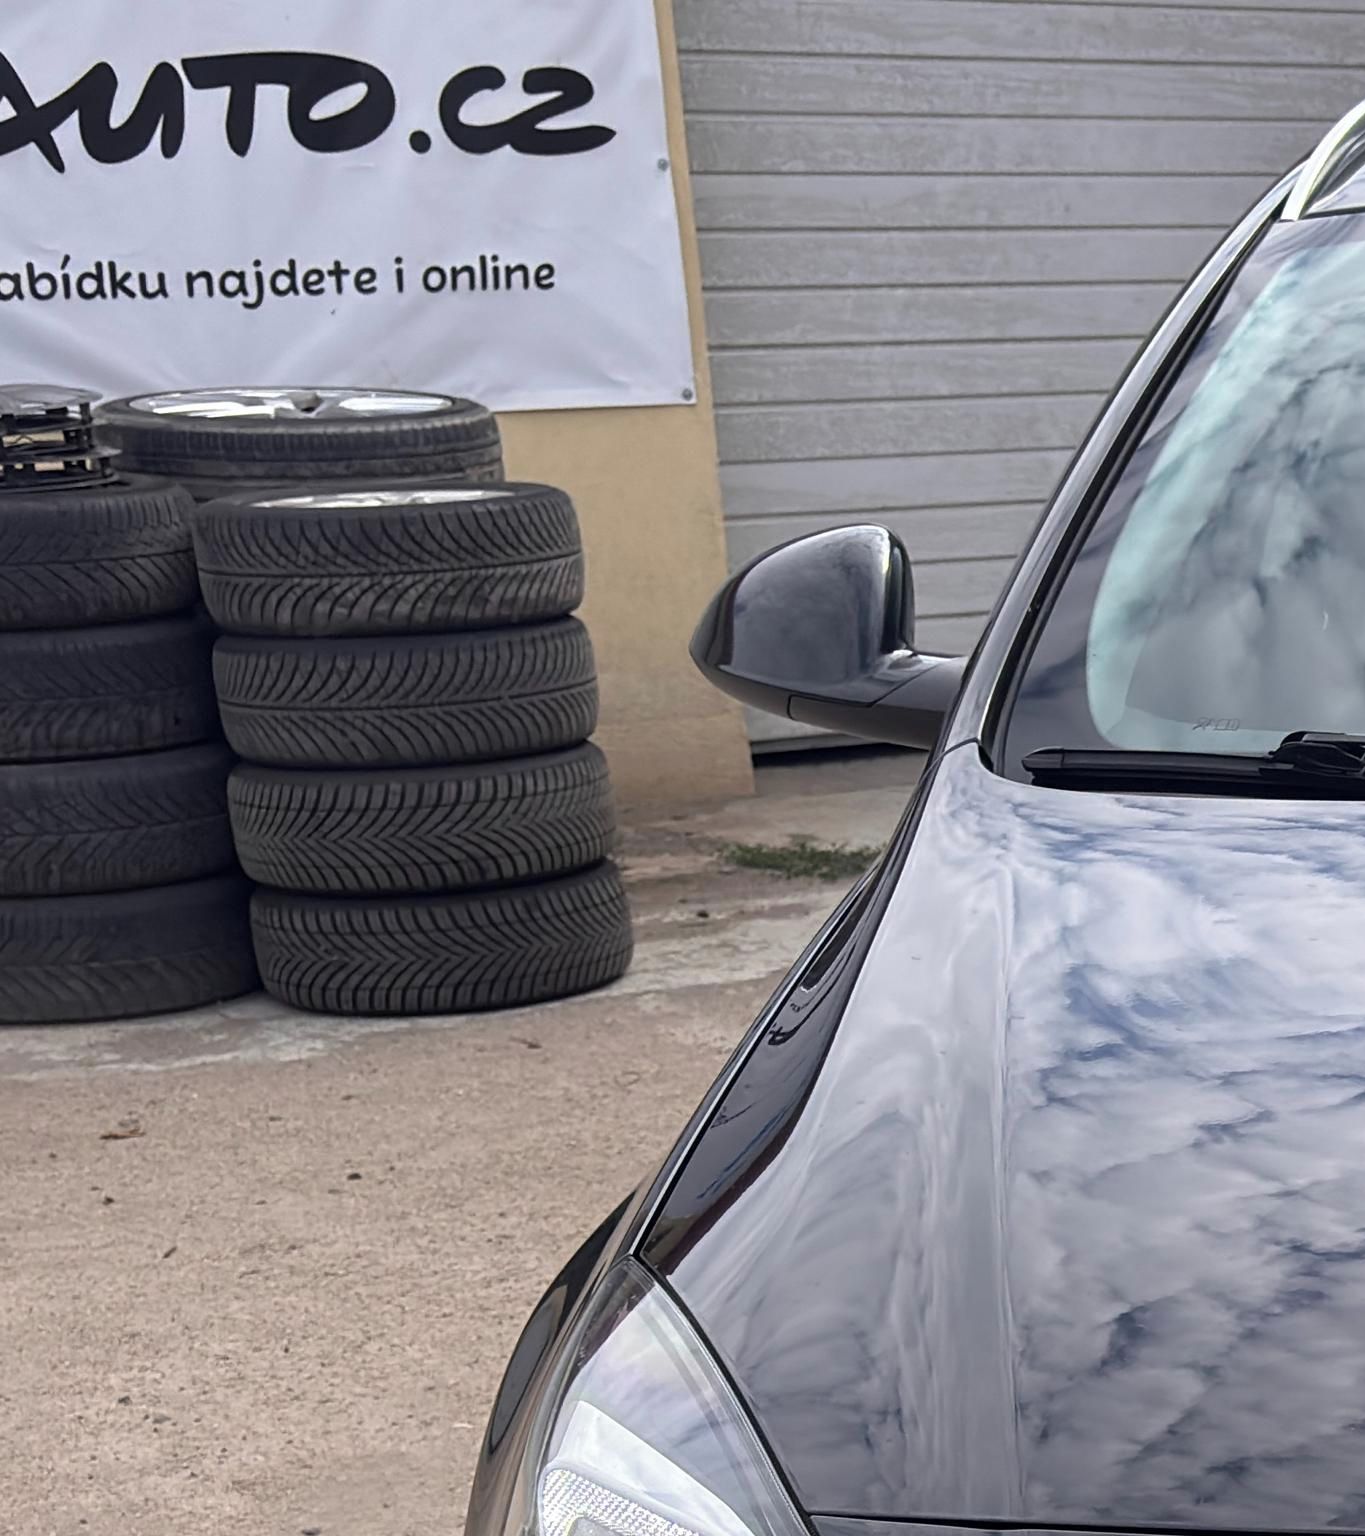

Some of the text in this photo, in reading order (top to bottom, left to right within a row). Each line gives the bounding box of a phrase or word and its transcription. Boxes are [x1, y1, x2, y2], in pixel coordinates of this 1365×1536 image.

[185, 258, 377, 310] najdete
[394, 256, 404, 293] i
[422, 254, 556, 294] online
